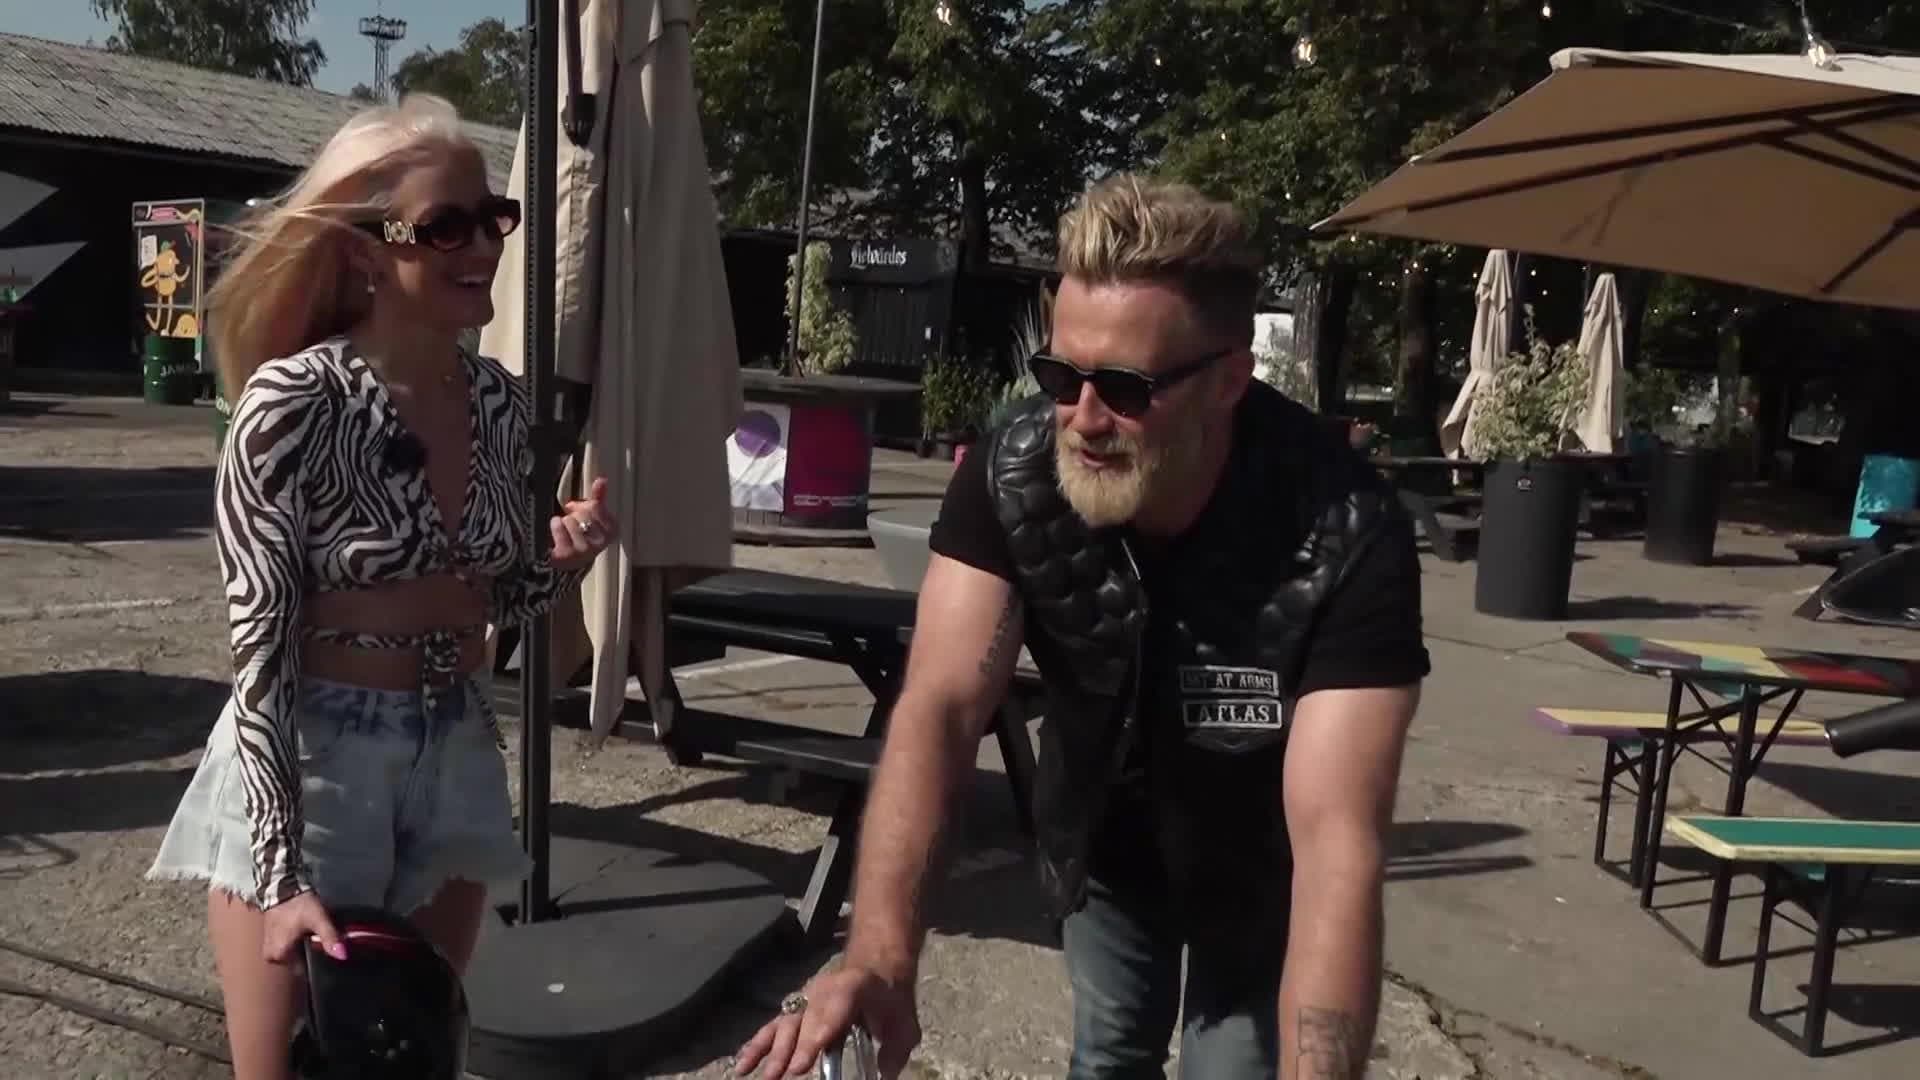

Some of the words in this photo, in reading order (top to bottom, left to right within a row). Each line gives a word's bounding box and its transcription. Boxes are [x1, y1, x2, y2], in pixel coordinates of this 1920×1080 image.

[1216, 672, 1233, 689] AT
[1240, 673, 1273, 690] ARMS
[1200, 704, 1270, 723] ATLAS
